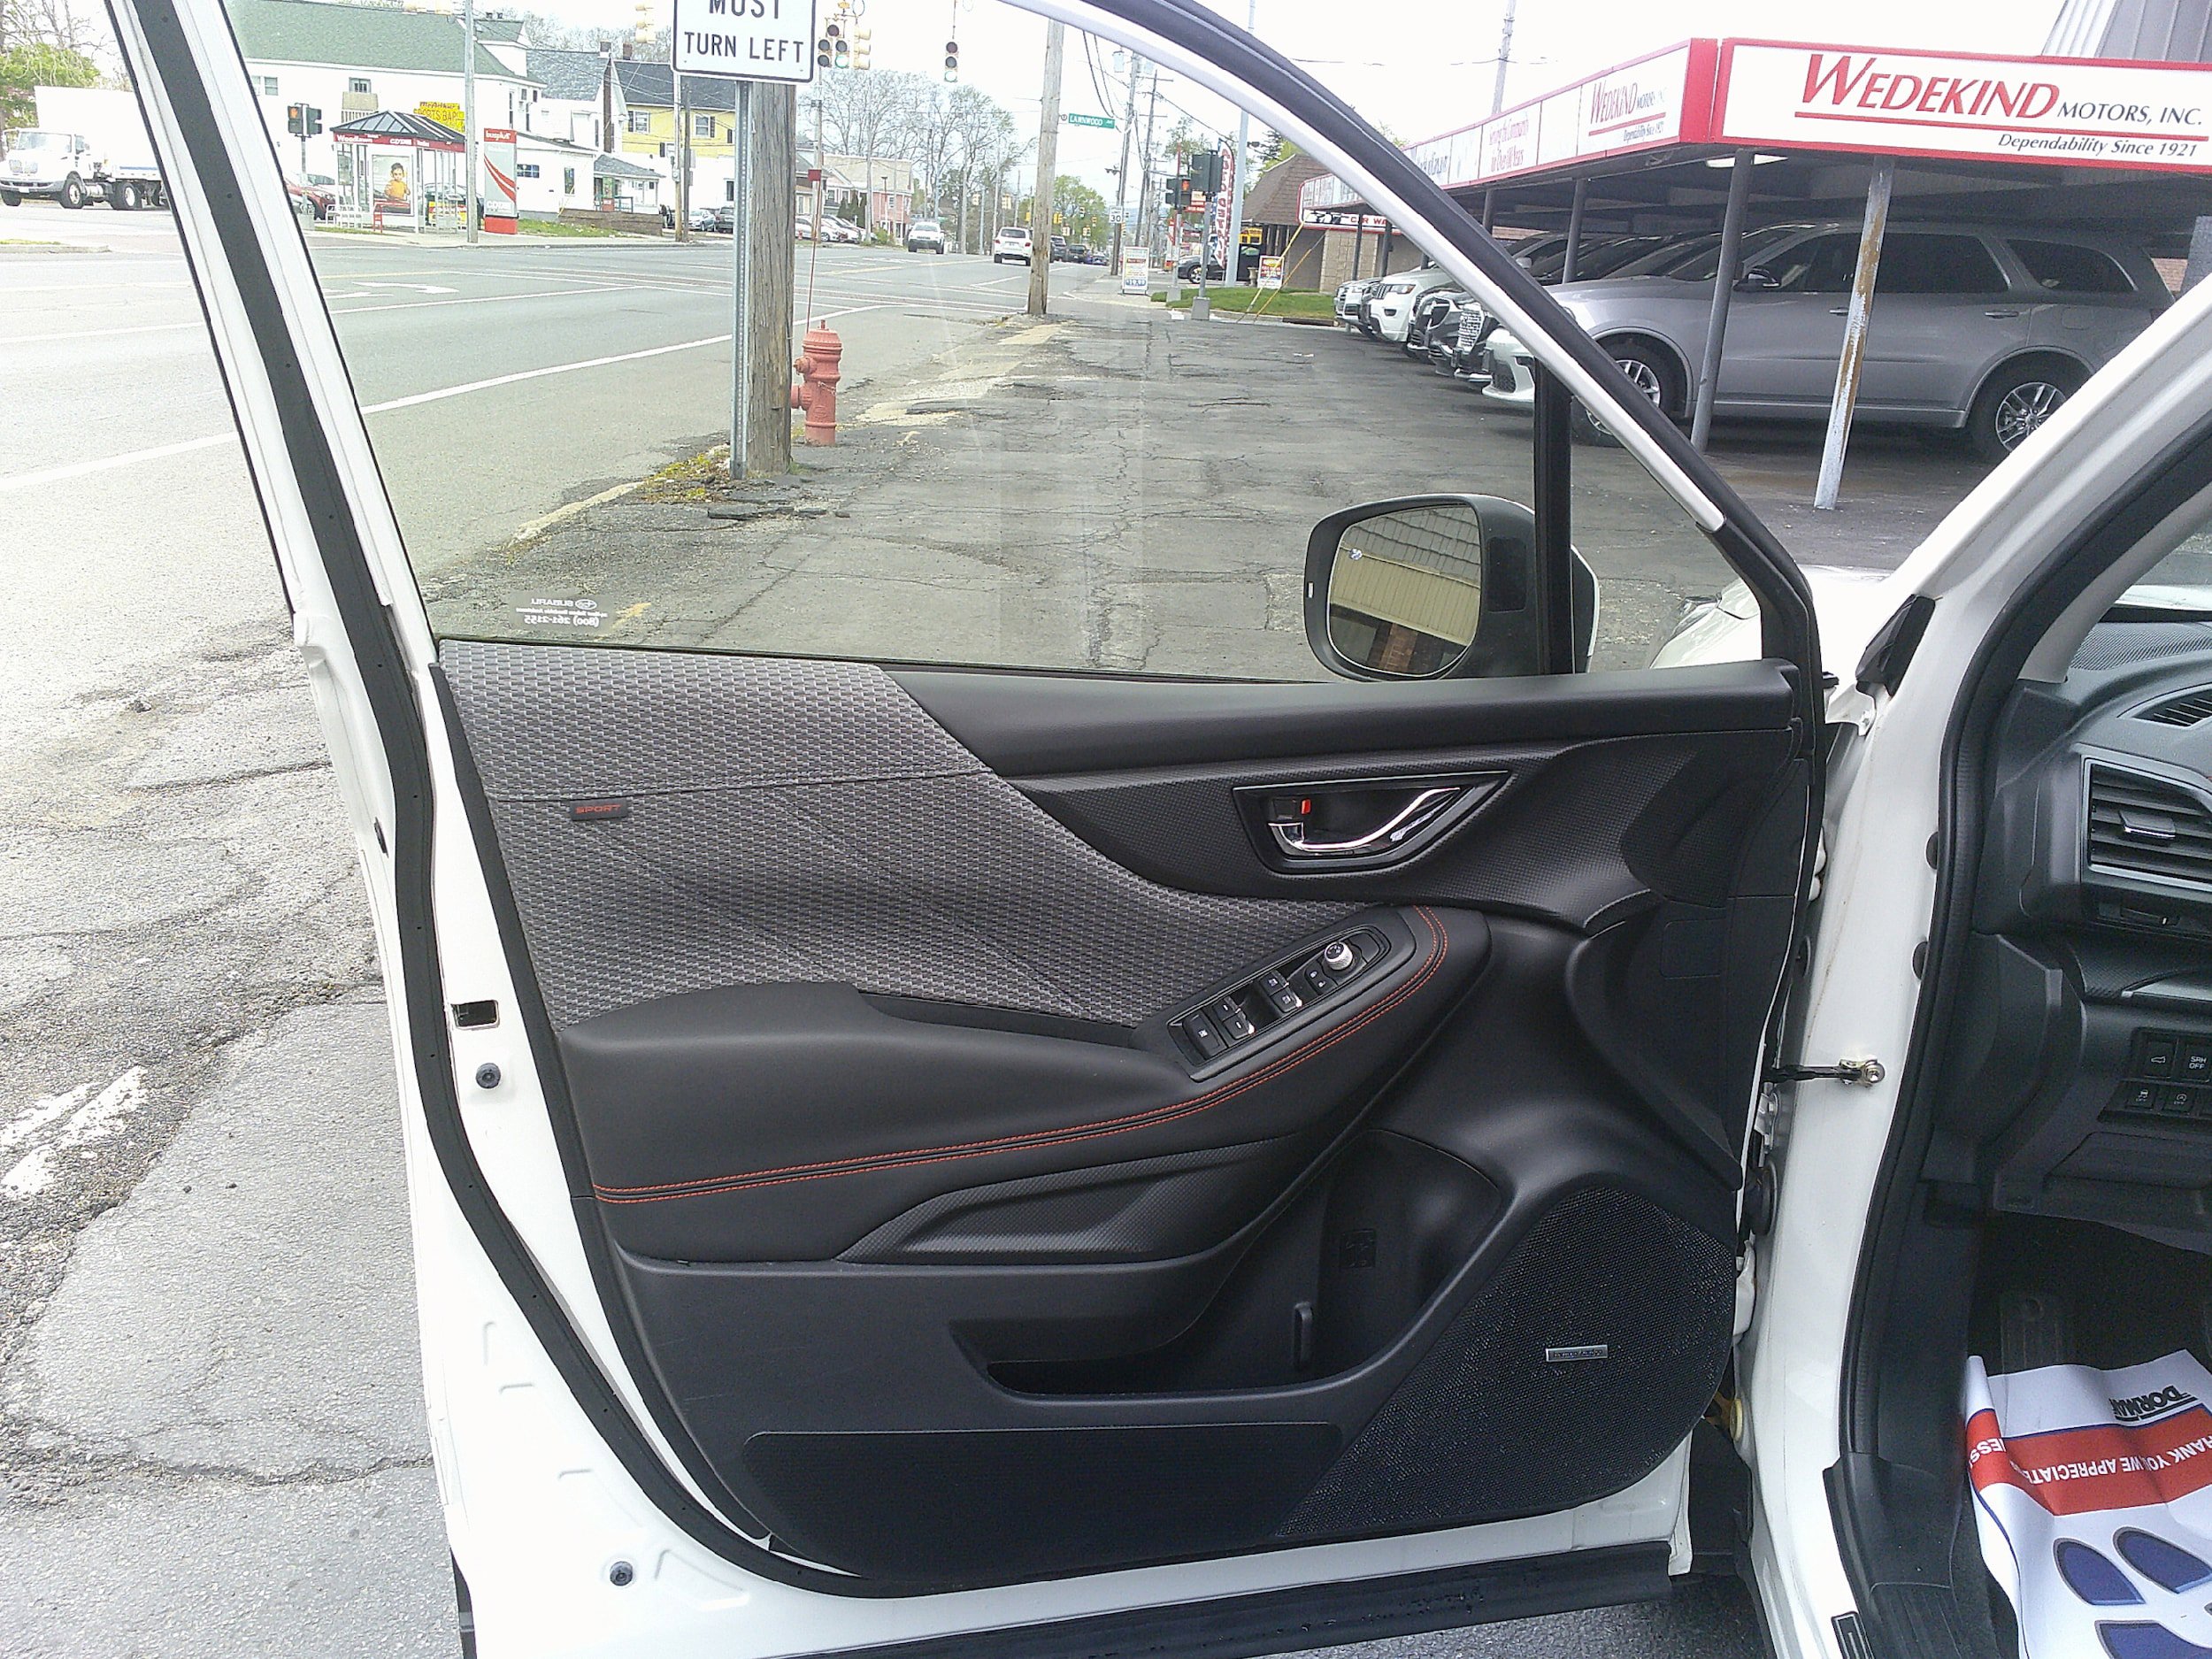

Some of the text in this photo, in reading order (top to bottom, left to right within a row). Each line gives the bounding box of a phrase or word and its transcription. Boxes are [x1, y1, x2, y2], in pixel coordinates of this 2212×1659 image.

[684, 32, 803, 63] TURN LEFT
[1590, 80, 1638, 124] WEDEKIND
[1802, 54, 2202, 125] WEDEKIND MOTORS, INC.
[1998, 134, 2198, 157] Dependability Since 1921
[1350, 216, 1369, 225] CR
[576, 804, 623, 814] SPORT
[2166, 1435, 2212, 1463] HANK
[2119, 1455, 2144, 1471] WE
